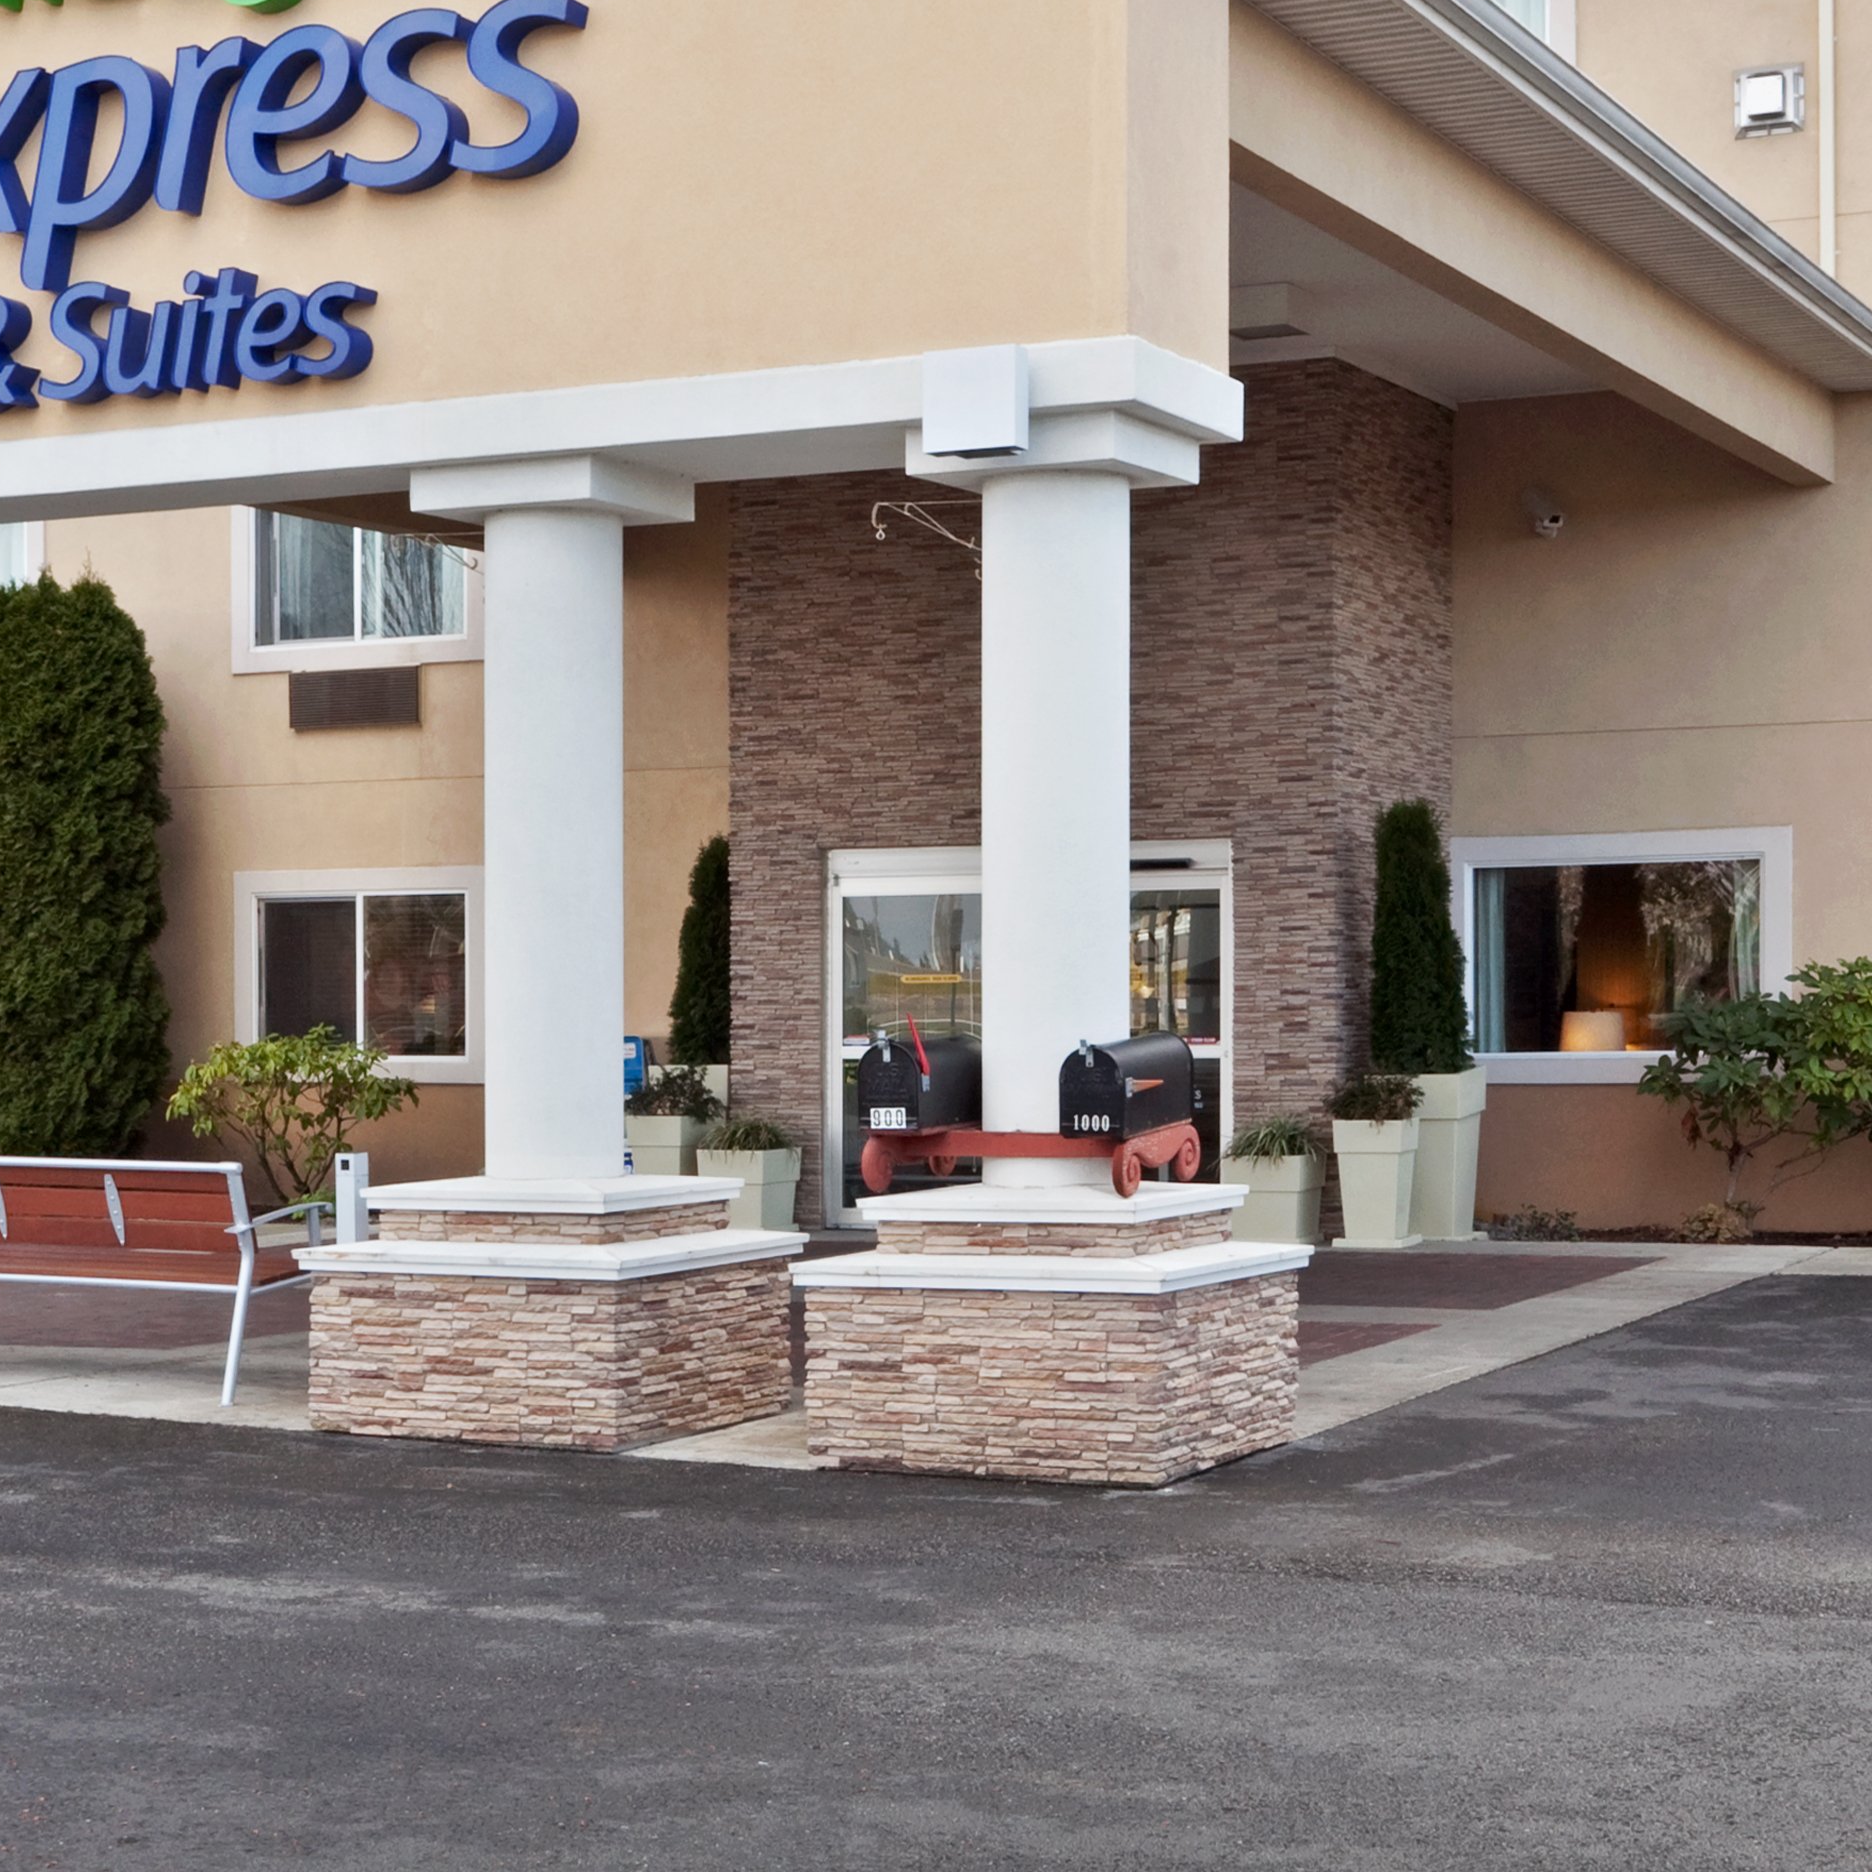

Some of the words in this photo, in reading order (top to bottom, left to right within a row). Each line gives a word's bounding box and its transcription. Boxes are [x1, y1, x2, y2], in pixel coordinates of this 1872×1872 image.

[39, 267, 377, 404] Suites
[872, 1109, 904, 1127] 900
[1073, 1113, 1111, 1132] 1000
